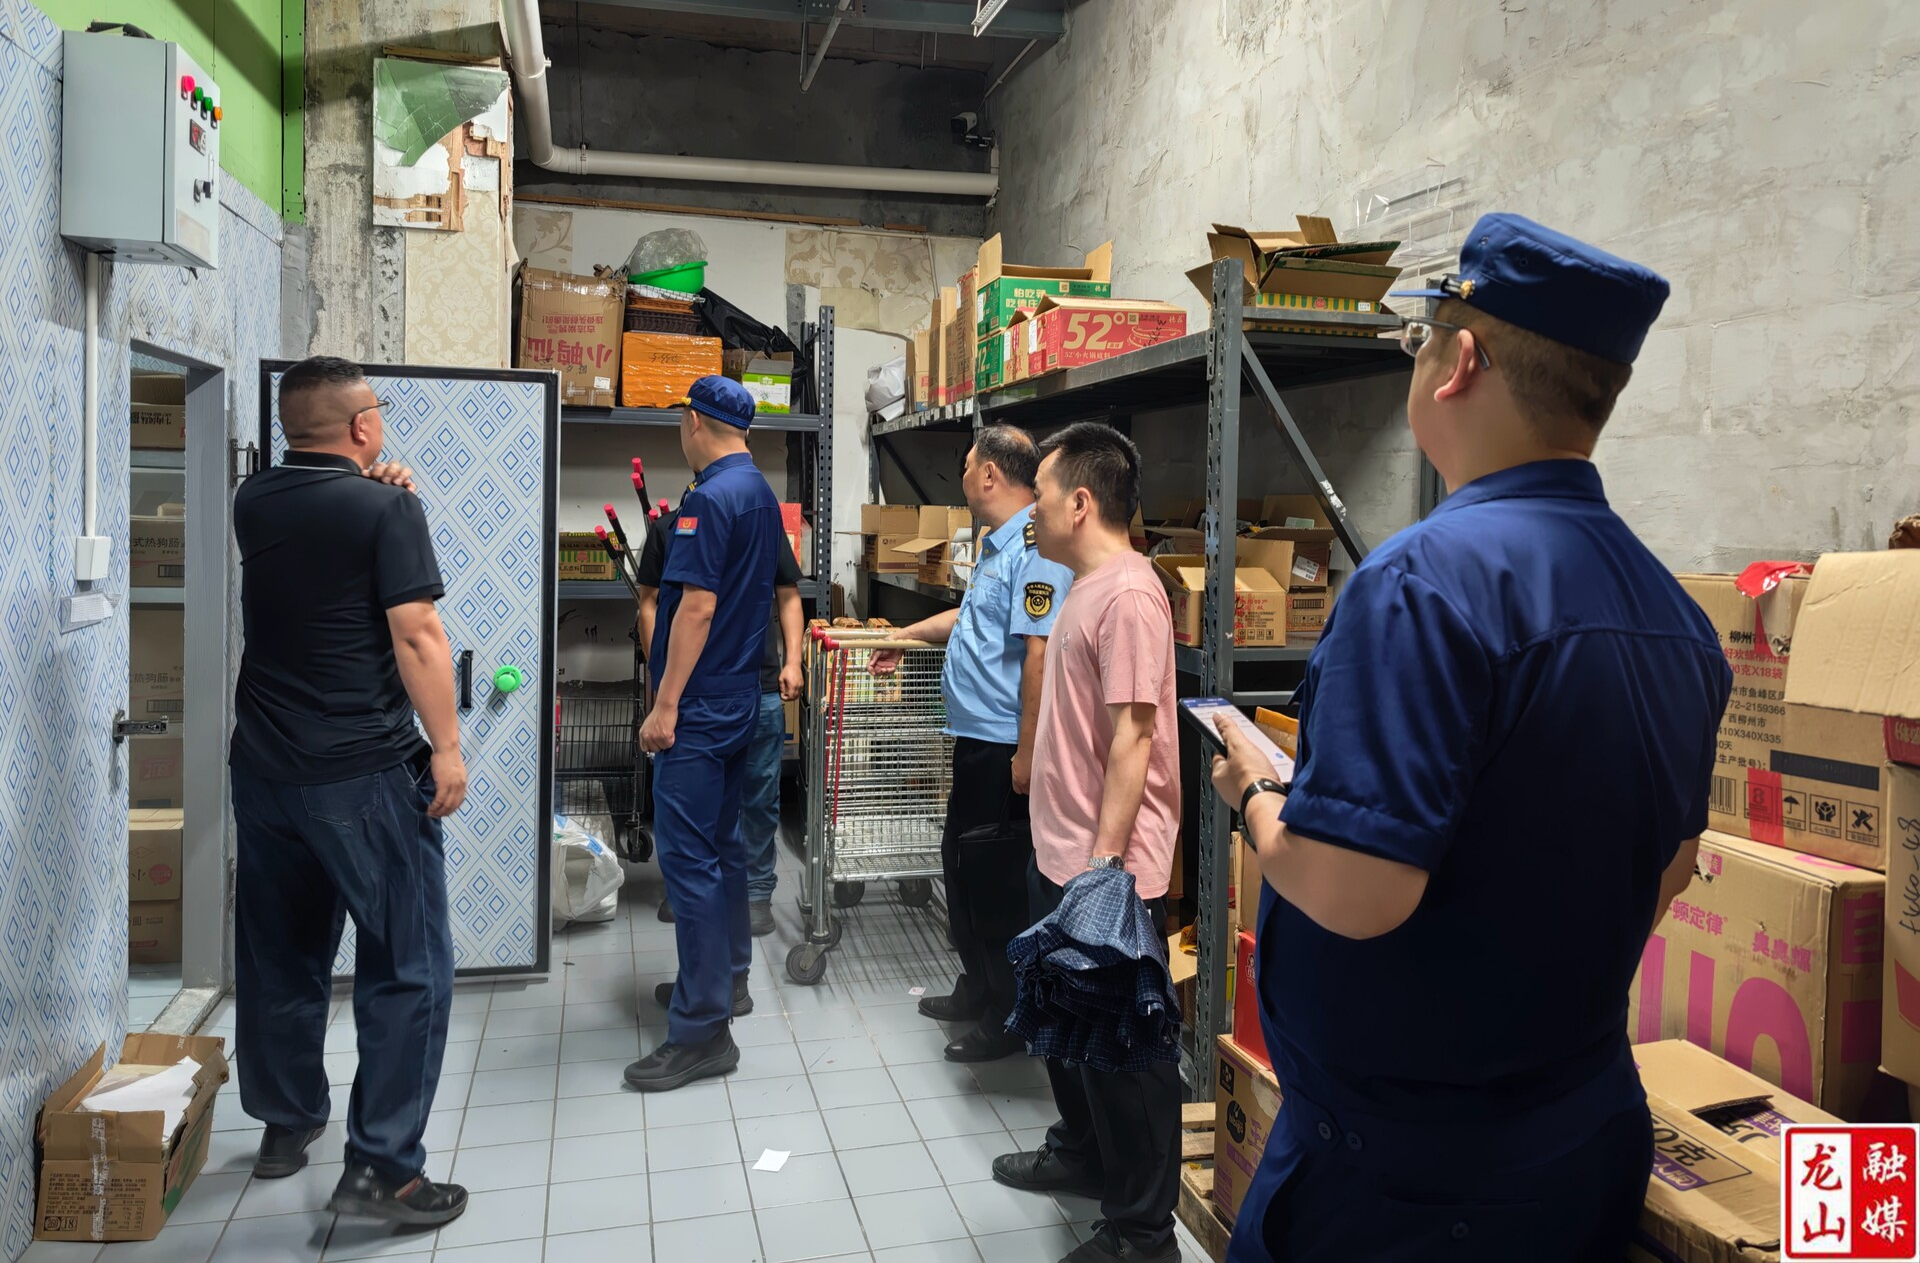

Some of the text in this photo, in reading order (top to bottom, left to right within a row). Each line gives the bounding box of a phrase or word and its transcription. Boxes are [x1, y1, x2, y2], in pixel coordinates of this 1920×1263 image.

[527, 337, 613, 369] 小鸭仙
[1715, 753, 1766, 771] 生产批号):
[1668, 898, 1724, 936] 顿定律
[1651, 1117, 1718, 1168] 0克
